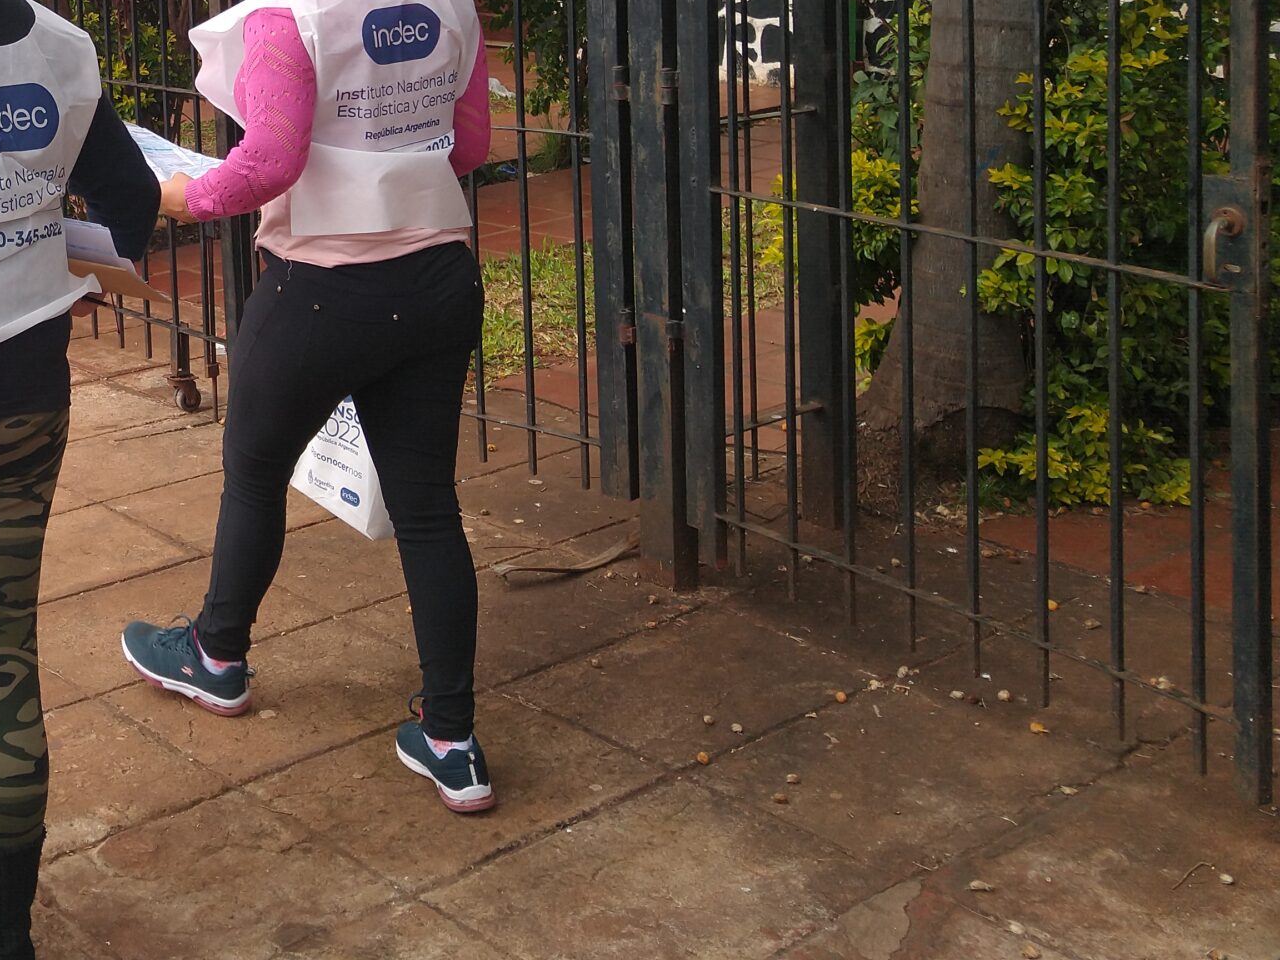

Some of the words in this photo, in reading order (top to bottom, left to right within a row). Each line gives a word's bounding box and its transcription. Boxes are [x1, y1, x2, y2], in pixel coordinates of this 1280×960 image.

[371, 20, 429, 48] indec
[336, 84, 394, 102] Instituto
[397, 71, 446, 95] Nacional
[448, 69, 458, 84] de
[337, 101, 410, 119] Estadística
[412, 100, 420, 114] y
[422, 90, 456, 109] Censos
[365, 124, 404, 141] República
[404, 117, 440, 133] Argentina
[15, 164, 58, 186] Naonal
[36, 187, 44, 205] y
[319, 417, 361, 449] 022
